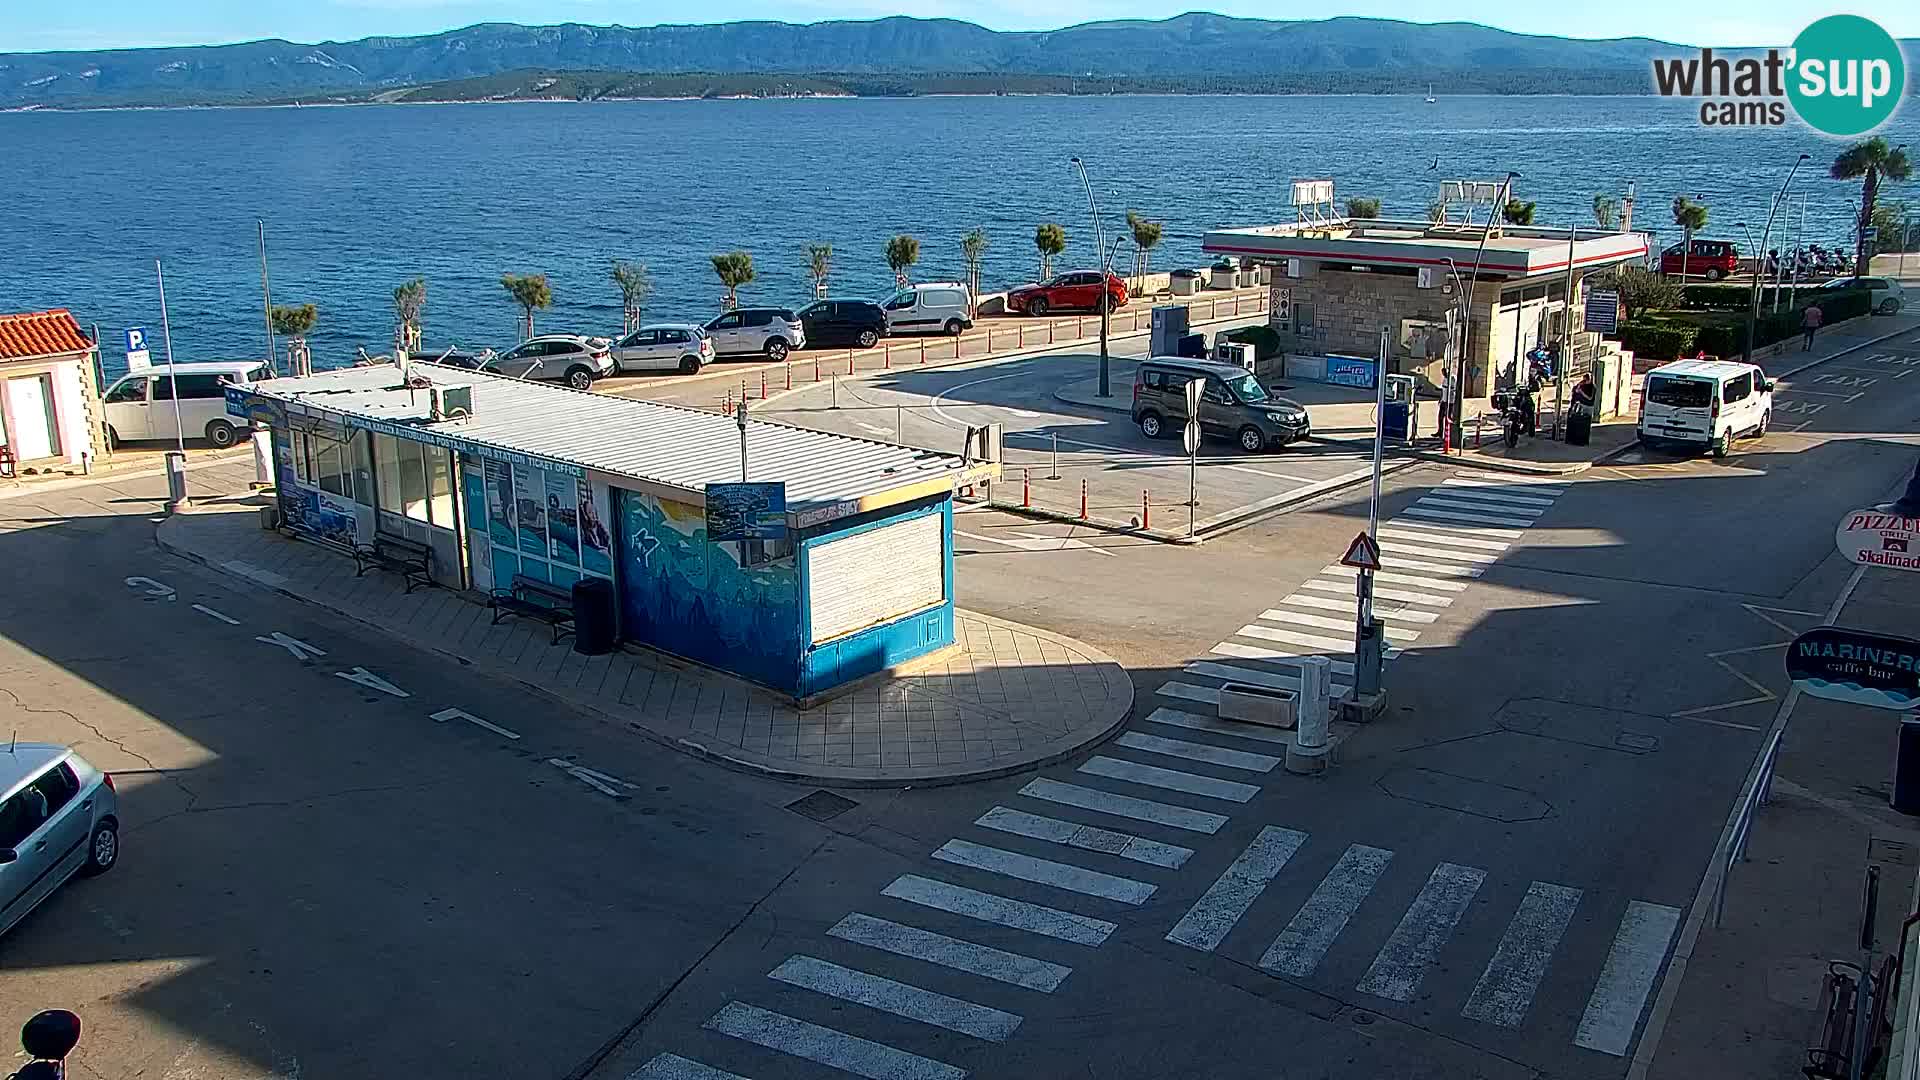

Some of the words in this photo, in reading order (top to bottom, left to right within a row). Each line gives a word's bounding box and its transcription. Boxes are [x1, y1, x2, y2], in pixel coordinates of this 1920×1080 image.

[1812, 374, 1879, 388] TAXI
[1773, 399, 1829, 415] AXI
[478, 447, 493, 458] BUS
[494, 450, 526, 465] STATION
[528, 456, 554, 471] TICKET
[555, 463, 582, 477] OFFICE
[1880, 530, 1914, 540] GRILL
[1868, 664, 1895, 680] bar
